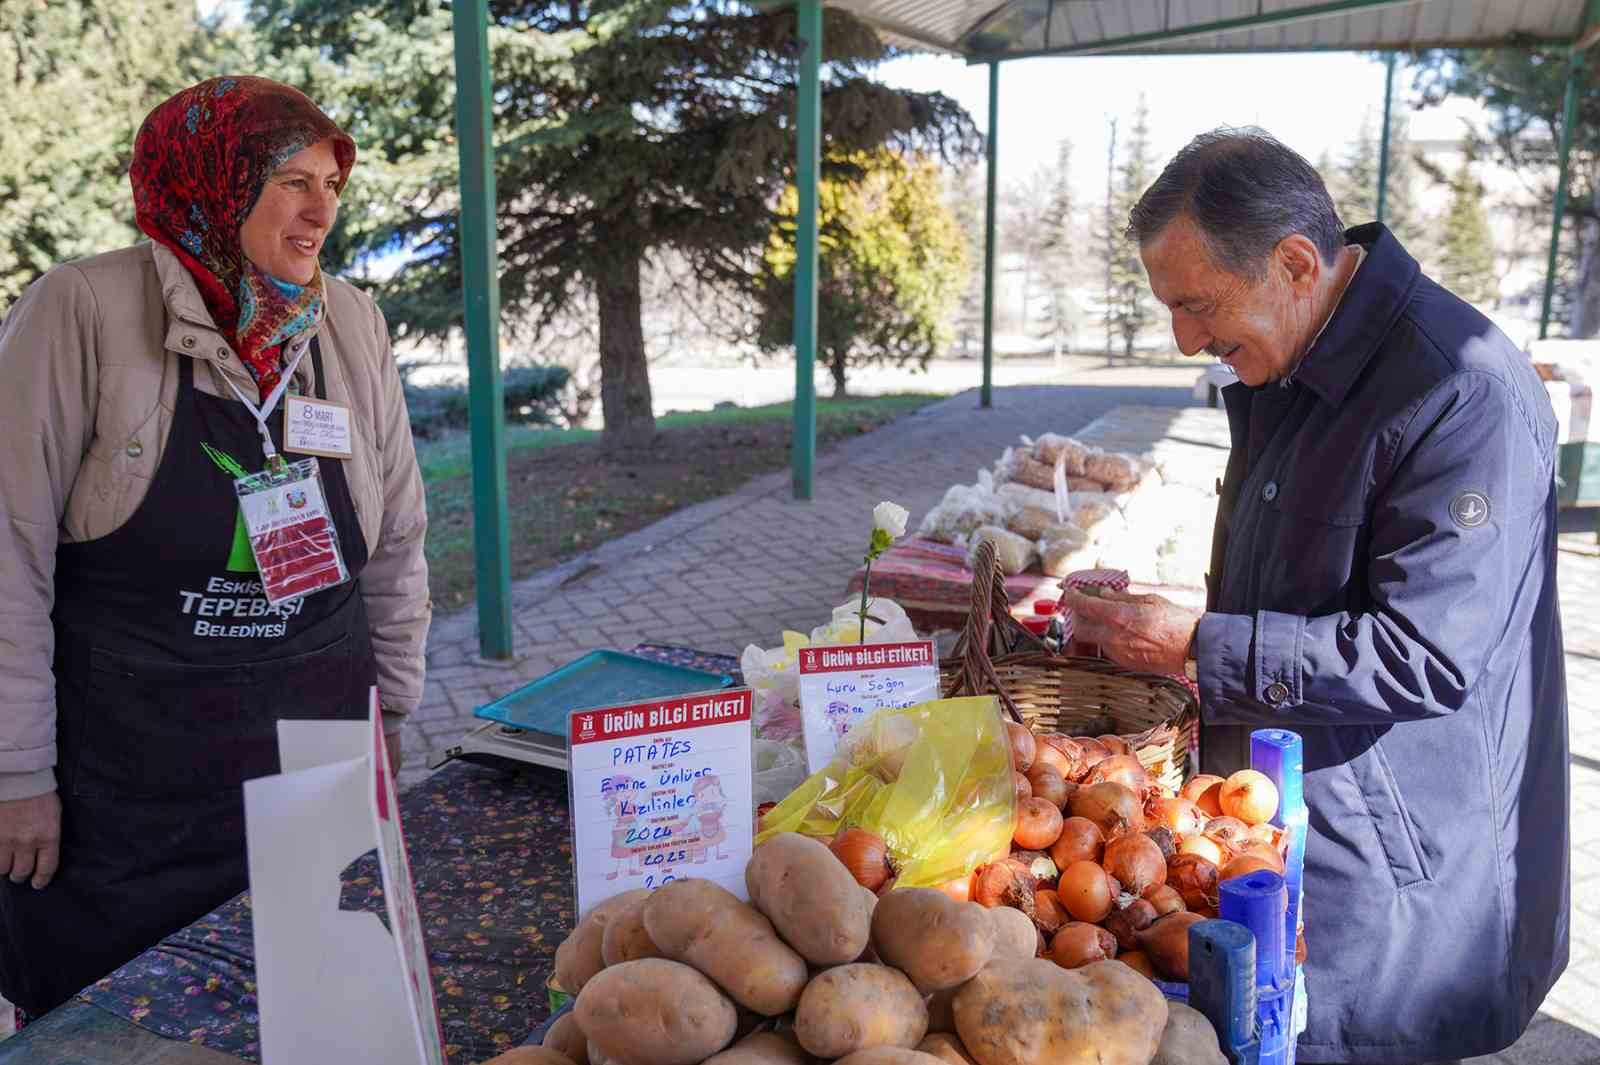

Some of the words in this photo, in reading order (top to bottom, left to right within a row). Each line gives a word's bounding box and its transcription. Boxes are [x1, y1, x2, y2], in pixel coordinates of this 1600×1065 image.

[303, 404, 313, 419] 8
[193, 619, 287, 638] BELEDİYESİ
[823, 649, 853, 668] ÜRÜN
[856, 647, 885, 665] BİLGİ
[888, 644, 929, 663] ETİKETİ
[603, 709, 644, 733] ÜRÜN
[649, 703, 688, 727] BİLGİ
[692, 695, 745, 721] ETİKETİ
[612, 740, 692, 766] PATATES
[601, 777, 647, 793] Emine
[625, 825, 672, 844] 2024
[644, 850, 686, 866] 2025
